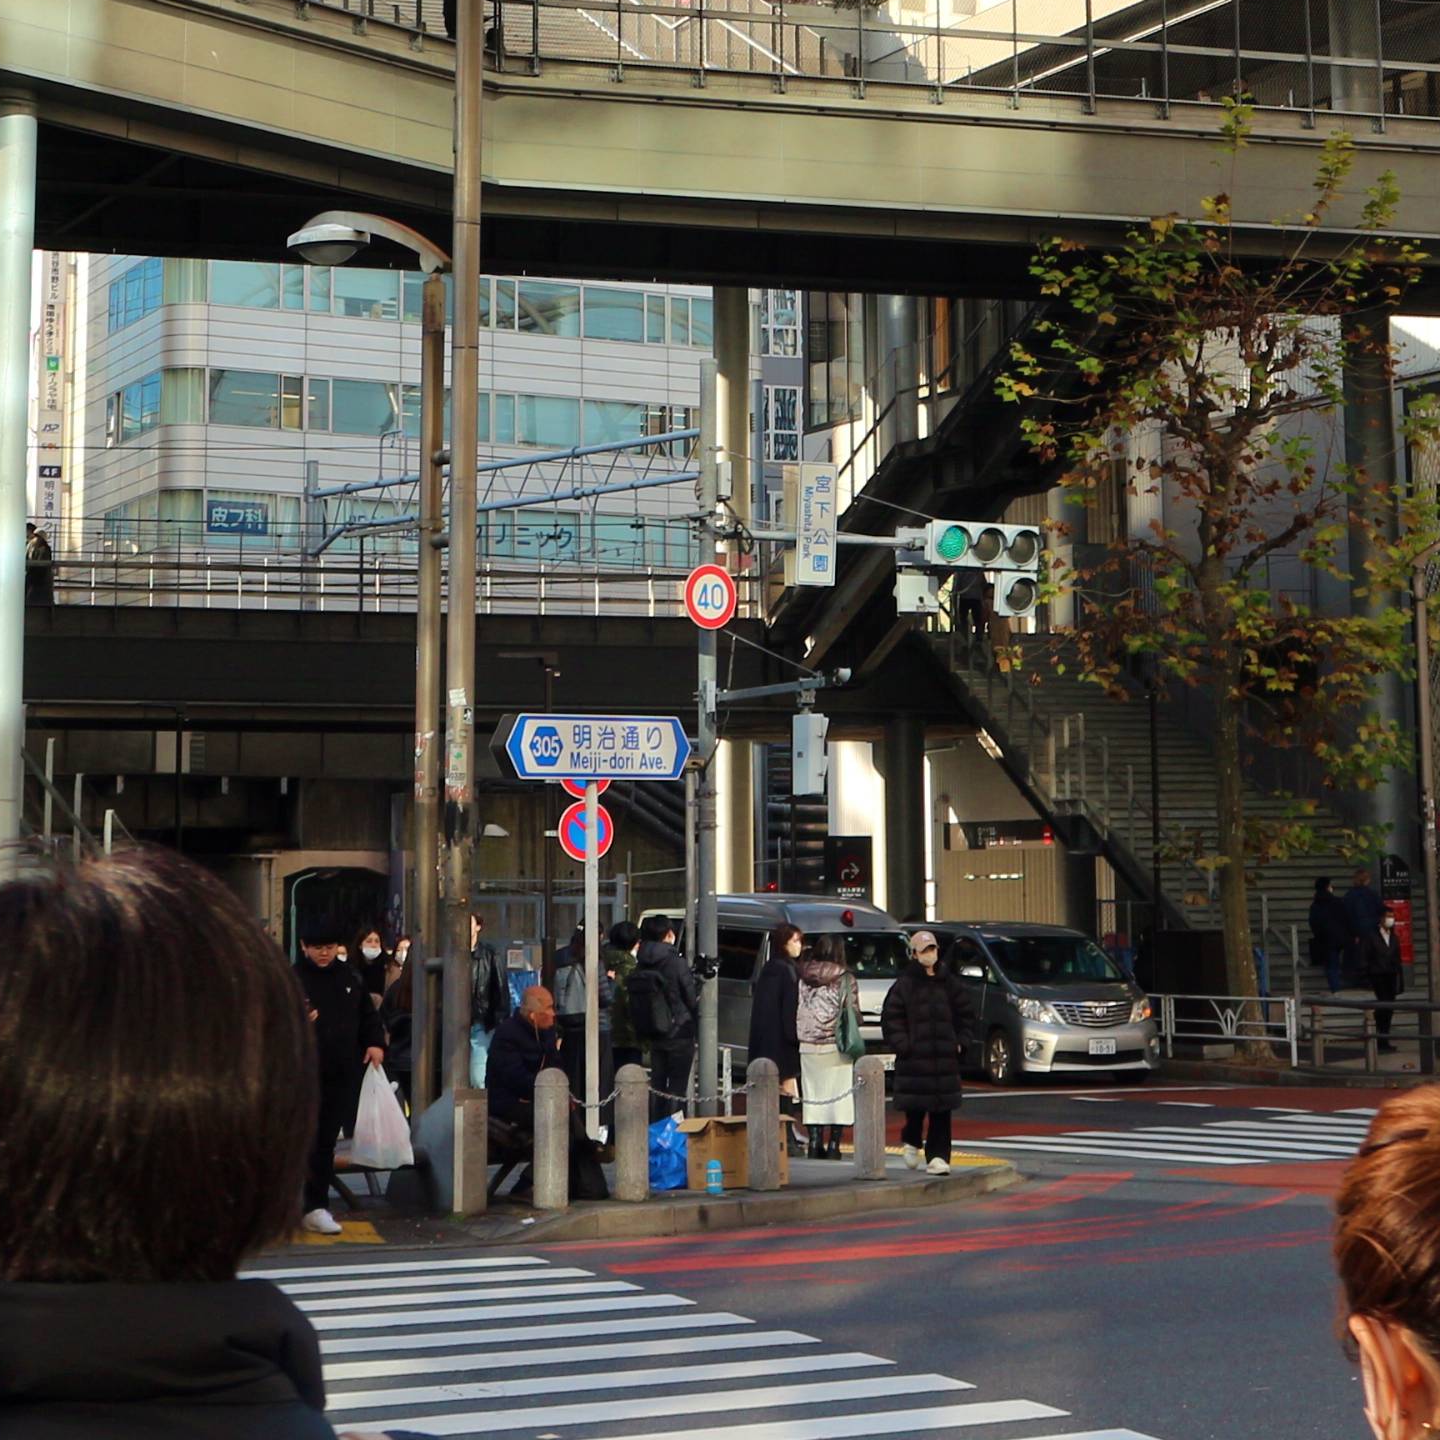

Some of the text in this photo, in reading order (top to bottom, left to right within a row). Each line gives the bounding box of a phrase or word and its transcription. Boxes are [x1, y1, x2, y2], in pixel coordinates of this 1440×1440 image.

[210, 507, 264, 531] 皮フ科
[802, 486, 814, 560] Miyashita Park
[813, 475, 832, 572] 宮下公園
[696, 583, 724, 610] 40
[532, 735, 561, 758] 305
[572, 723, 663, 751] 明治通り
[569, 751, 667, 773] Meiji-dori Ave.
